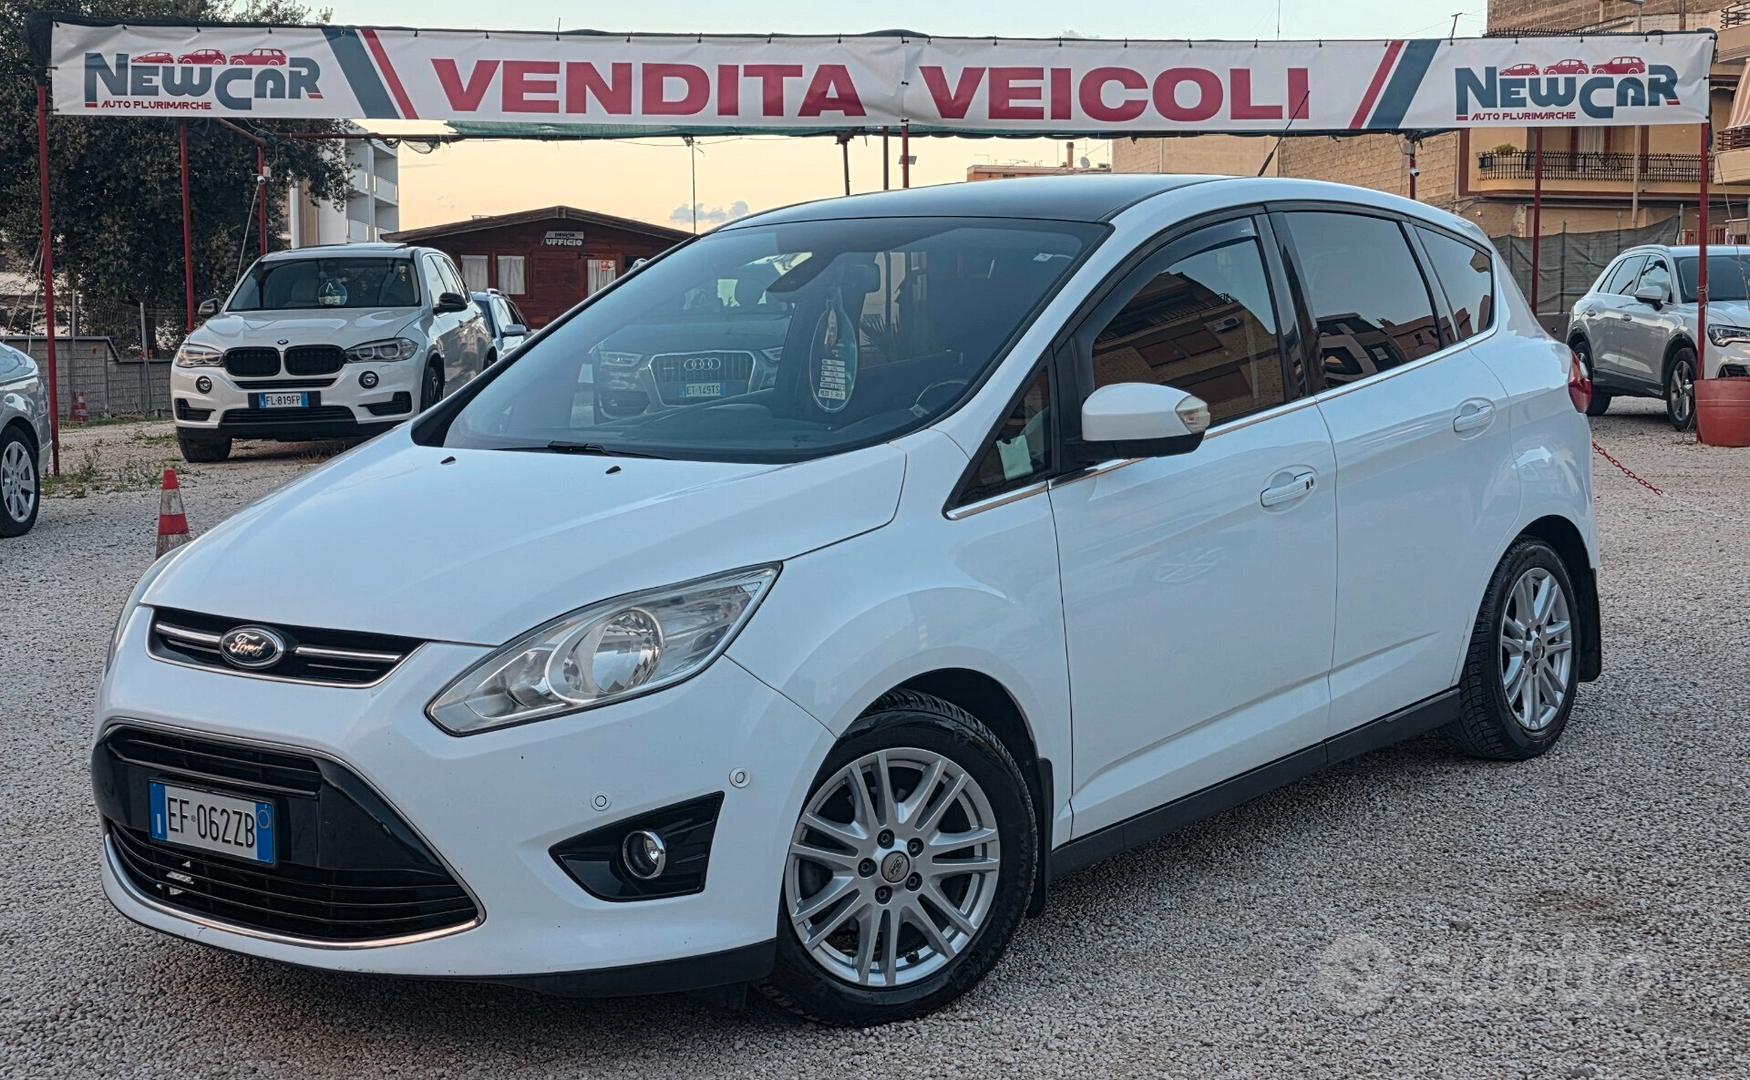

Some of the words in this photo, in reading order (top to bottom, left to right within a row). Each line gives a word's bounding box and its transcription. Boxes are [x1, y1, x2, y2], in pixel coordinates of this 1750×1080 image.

[430, 58, 867, 117] VENDITA
[918, 66, 1309, 122] VEICOLI
[101, 101, 131, 109] AUTO
[133, 101, 212, 110] PLURIMARCHE
[1471, 112, 1500, 121] AUTO
[1502, 111, 1577, 121] PLURIMARCHE
[230, 633, 266, 657] Ford
